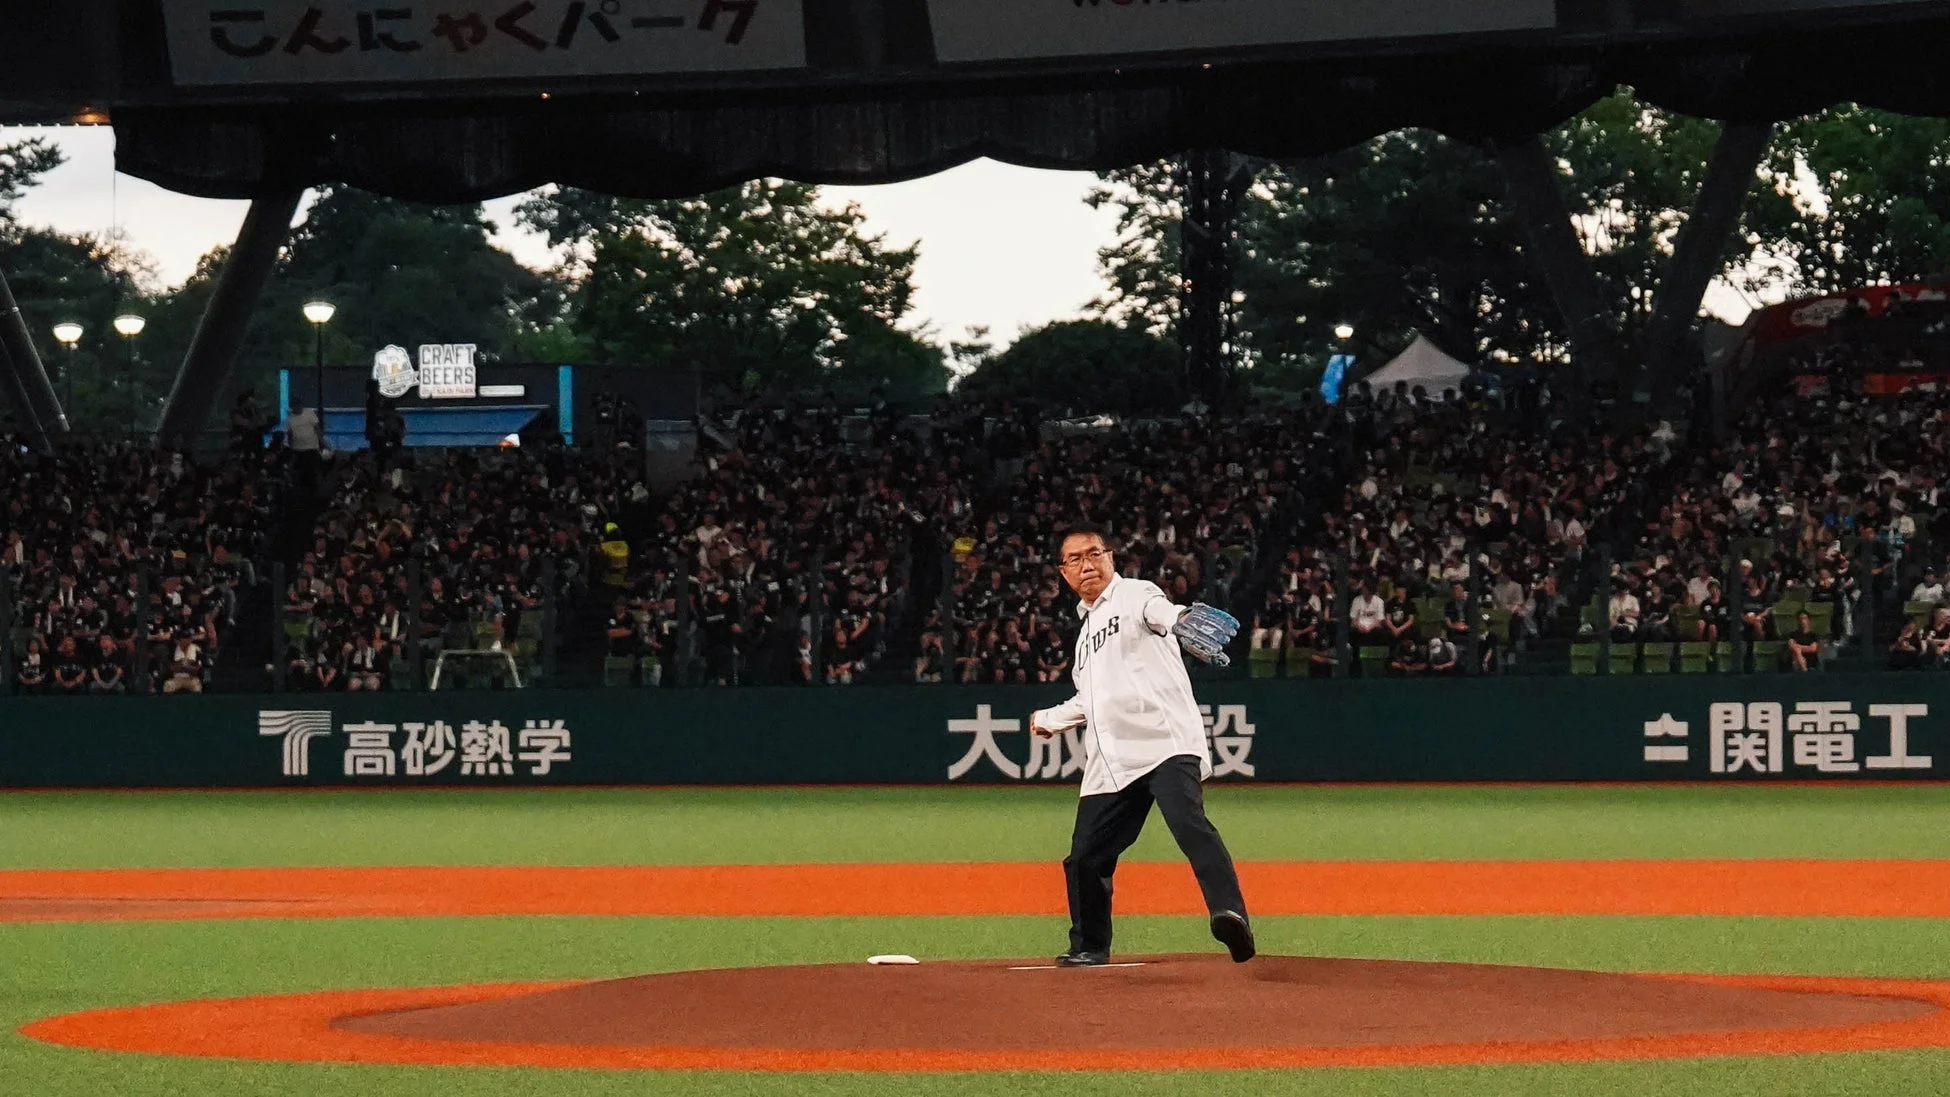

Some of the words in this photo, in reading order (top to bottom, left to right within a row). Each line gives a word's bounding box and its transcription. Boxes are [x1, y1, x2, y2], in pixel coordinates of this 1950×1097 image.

[210, 0, 755, 57] こんにゃくパーク
[422, 346, 475, 364] CRAFT
[422, 367, 474, 385] BEERS
[342, 719, 571, 776] 高砂熱学
[1710, 701, 1932, 773] 関電工
